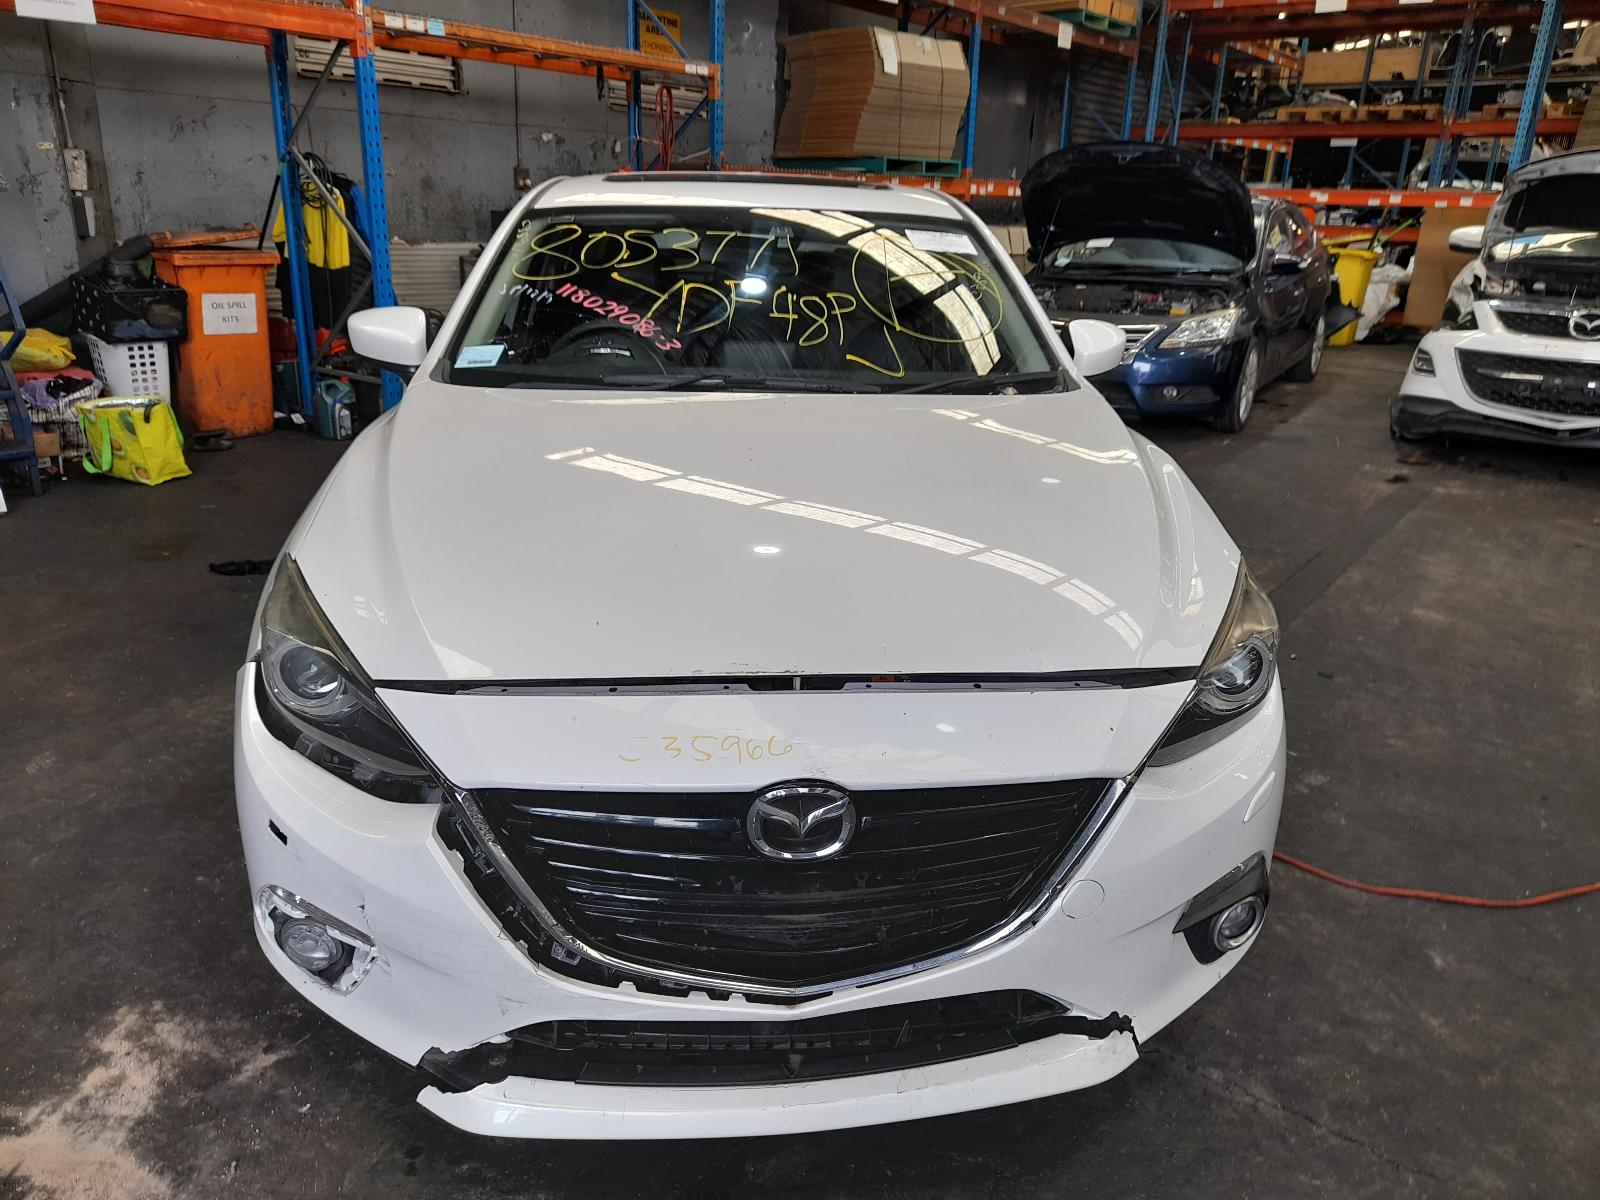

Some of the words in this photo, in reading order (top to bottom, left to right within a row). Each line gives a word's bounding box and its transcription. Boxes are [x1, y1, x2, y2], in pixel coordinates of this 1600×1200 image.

[211, 302, 225, 310] OIL
[226, 301, 247, 310] SPILL
[222, 315, 240, 323] KITS
